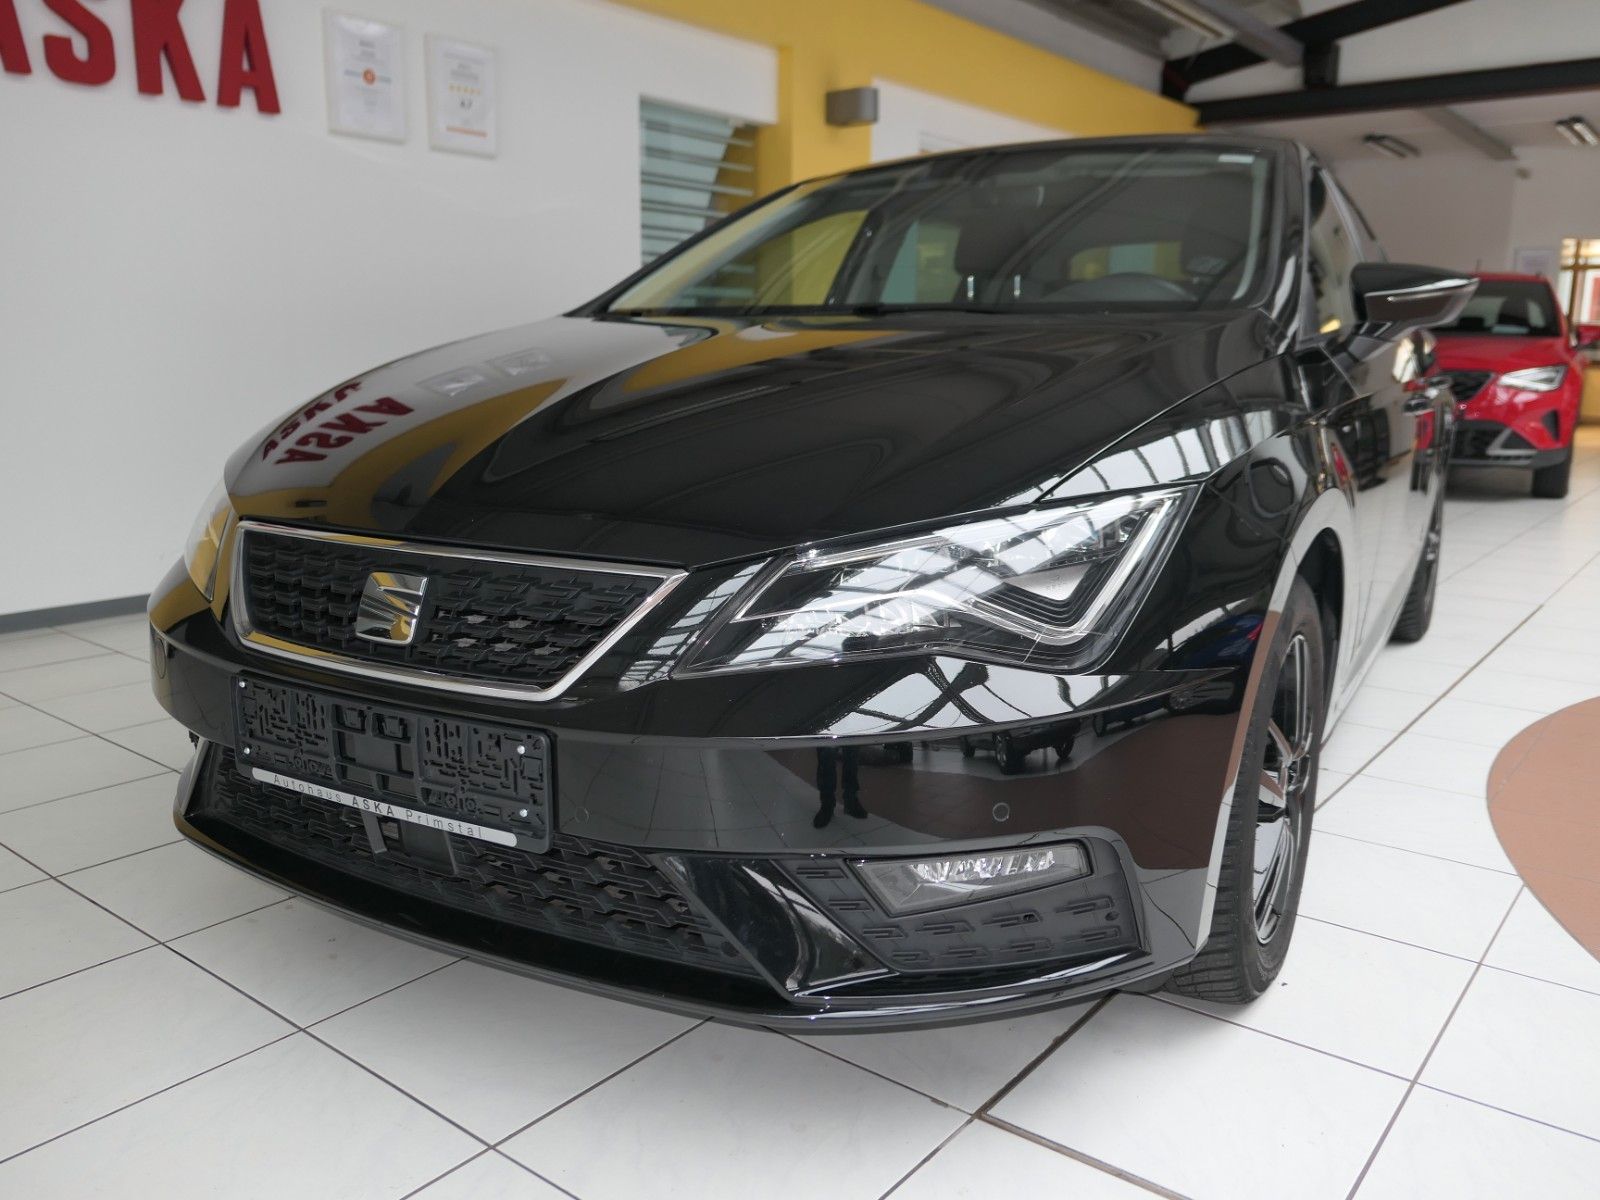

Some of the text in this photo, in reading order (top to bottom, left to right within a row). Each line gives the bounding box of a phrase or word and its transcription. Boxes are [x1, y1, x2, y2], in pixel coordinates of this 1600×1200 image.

[273, 774, 483, 839] Autohaus ASKA Primstal
